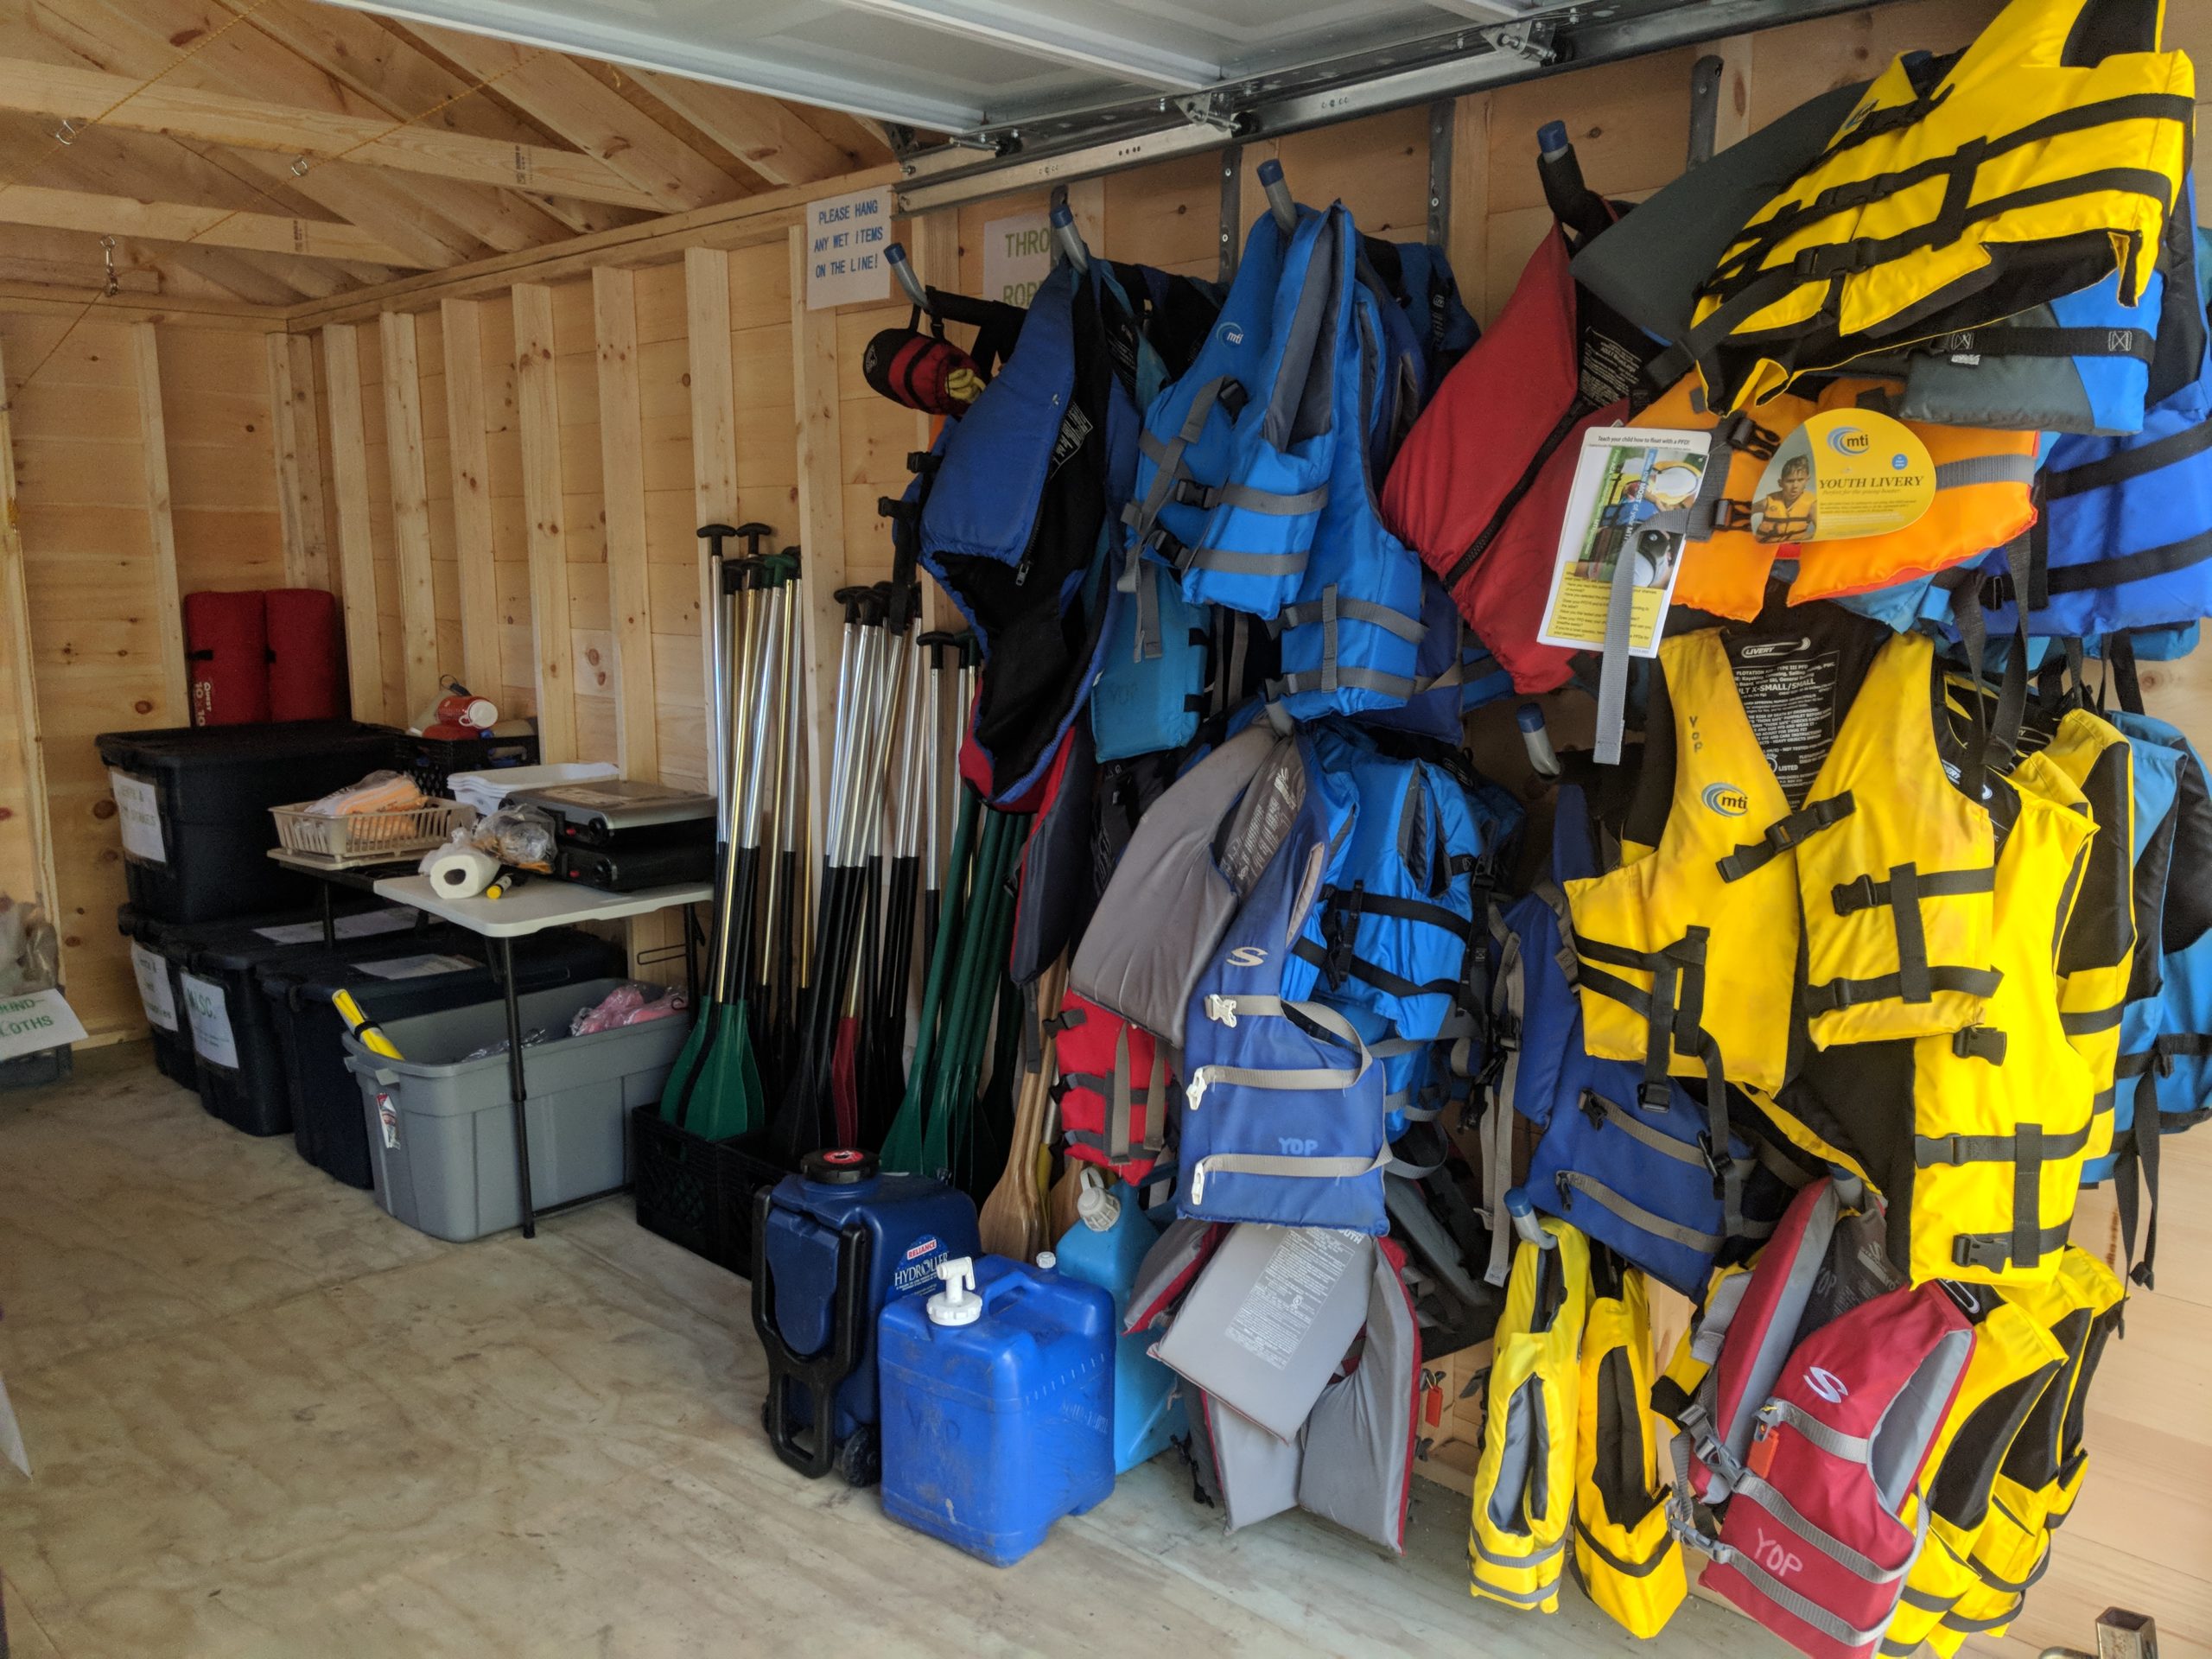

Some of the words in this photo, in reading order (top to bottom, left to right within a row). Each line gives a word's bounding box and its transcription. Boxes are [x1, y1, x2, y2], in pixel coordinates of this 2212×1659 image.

[819, 206, 849, 225] PLEASE
[855, 200, 878, 217] HANG
[814, 237, 830, 252] ANY
[833, 232, 849, 249] WET
[855, 226, 883, 244] ITEMS
[1005, 227, 1051, 257] THRO
[816, 264, 826, 278] ON
[830, 259, 845, 275] THE
[850, 253, 878, 272] LINE!
[1847, 434, 1868, 448] mti
[1637, 481, 1647, 503] MOST
[1820, 478, 1866, 489] YOUTH
[1870, 475, 1924, 487] LIVERY
[1745, 646, 1775, 655] LIVERY
[1721, 795, 1749, 810] mti
[0, 1015, 54, 1038] LOTHS
[1279, 1137, 1319, 1156] YOP
[908, 1241, 935, 1258] RELIANCE
[1754, 1528, 1803, 1577] YOP
